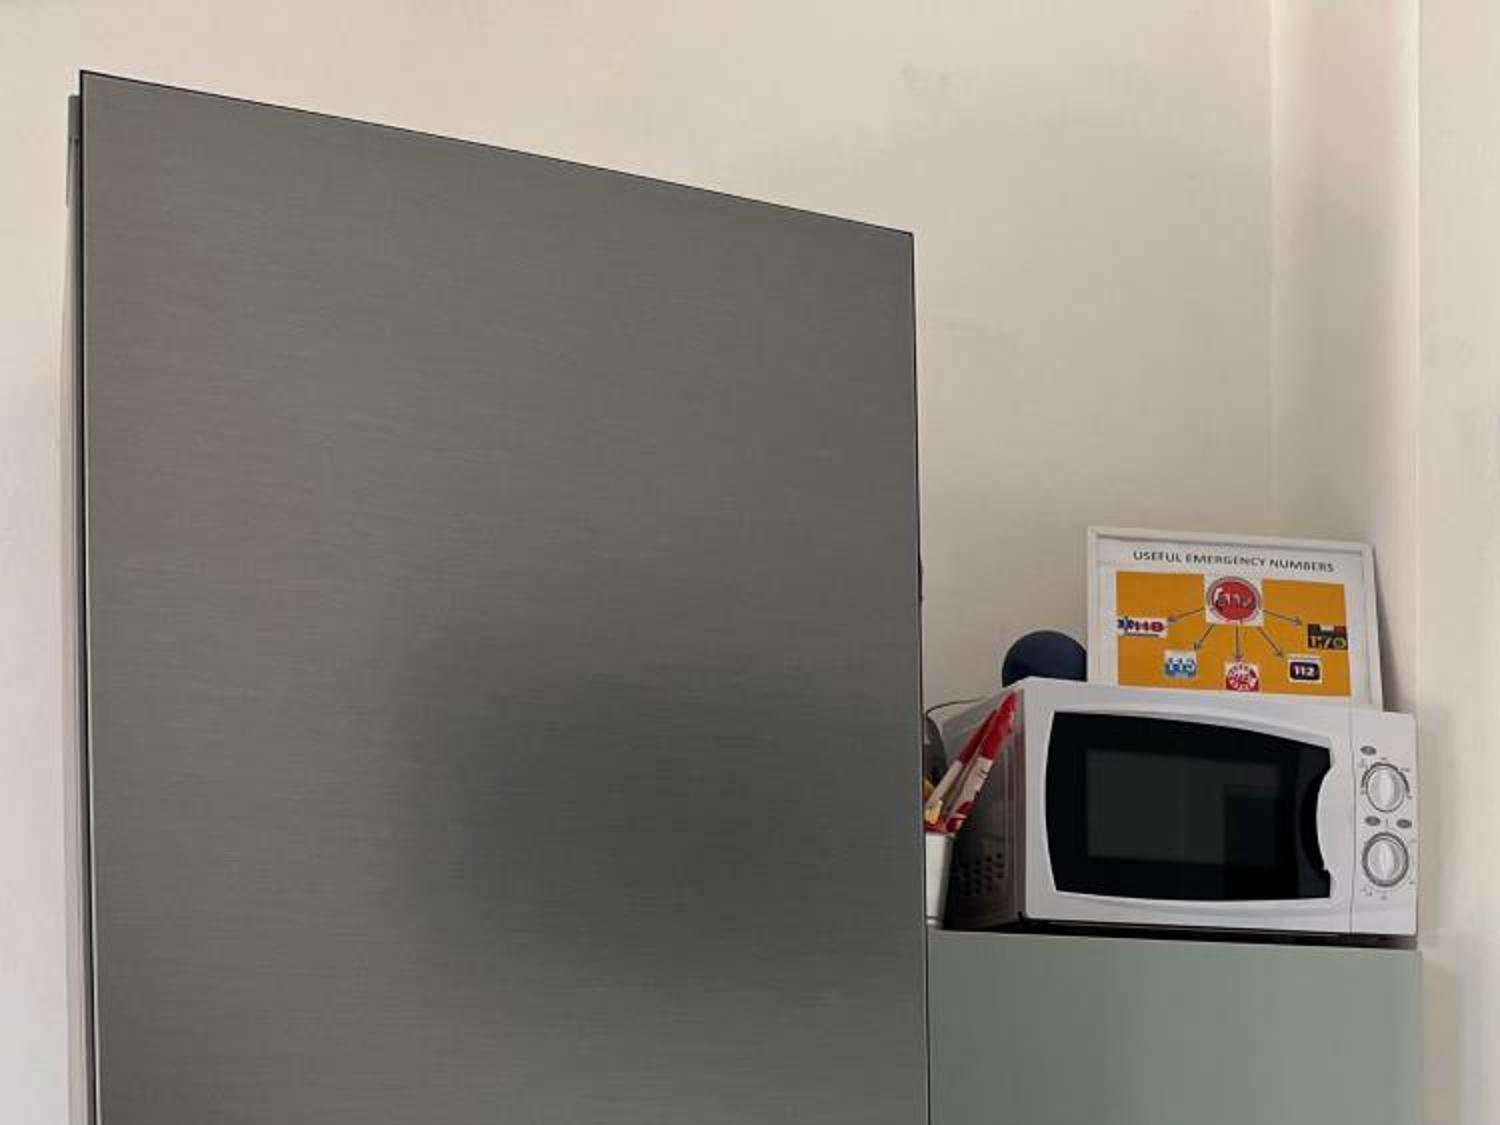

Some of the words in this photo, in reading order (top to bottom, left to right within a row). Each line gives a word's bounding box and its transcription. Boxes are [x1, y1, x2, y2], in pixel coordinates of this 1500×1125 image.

[1133, 550, 1182, 563] USEFUL
[1185, 553, 1266, 567] EMERGENCY
[1269, 559, 1335, 573] NUMBERS
[1293, 664, 1316, 677] 112
